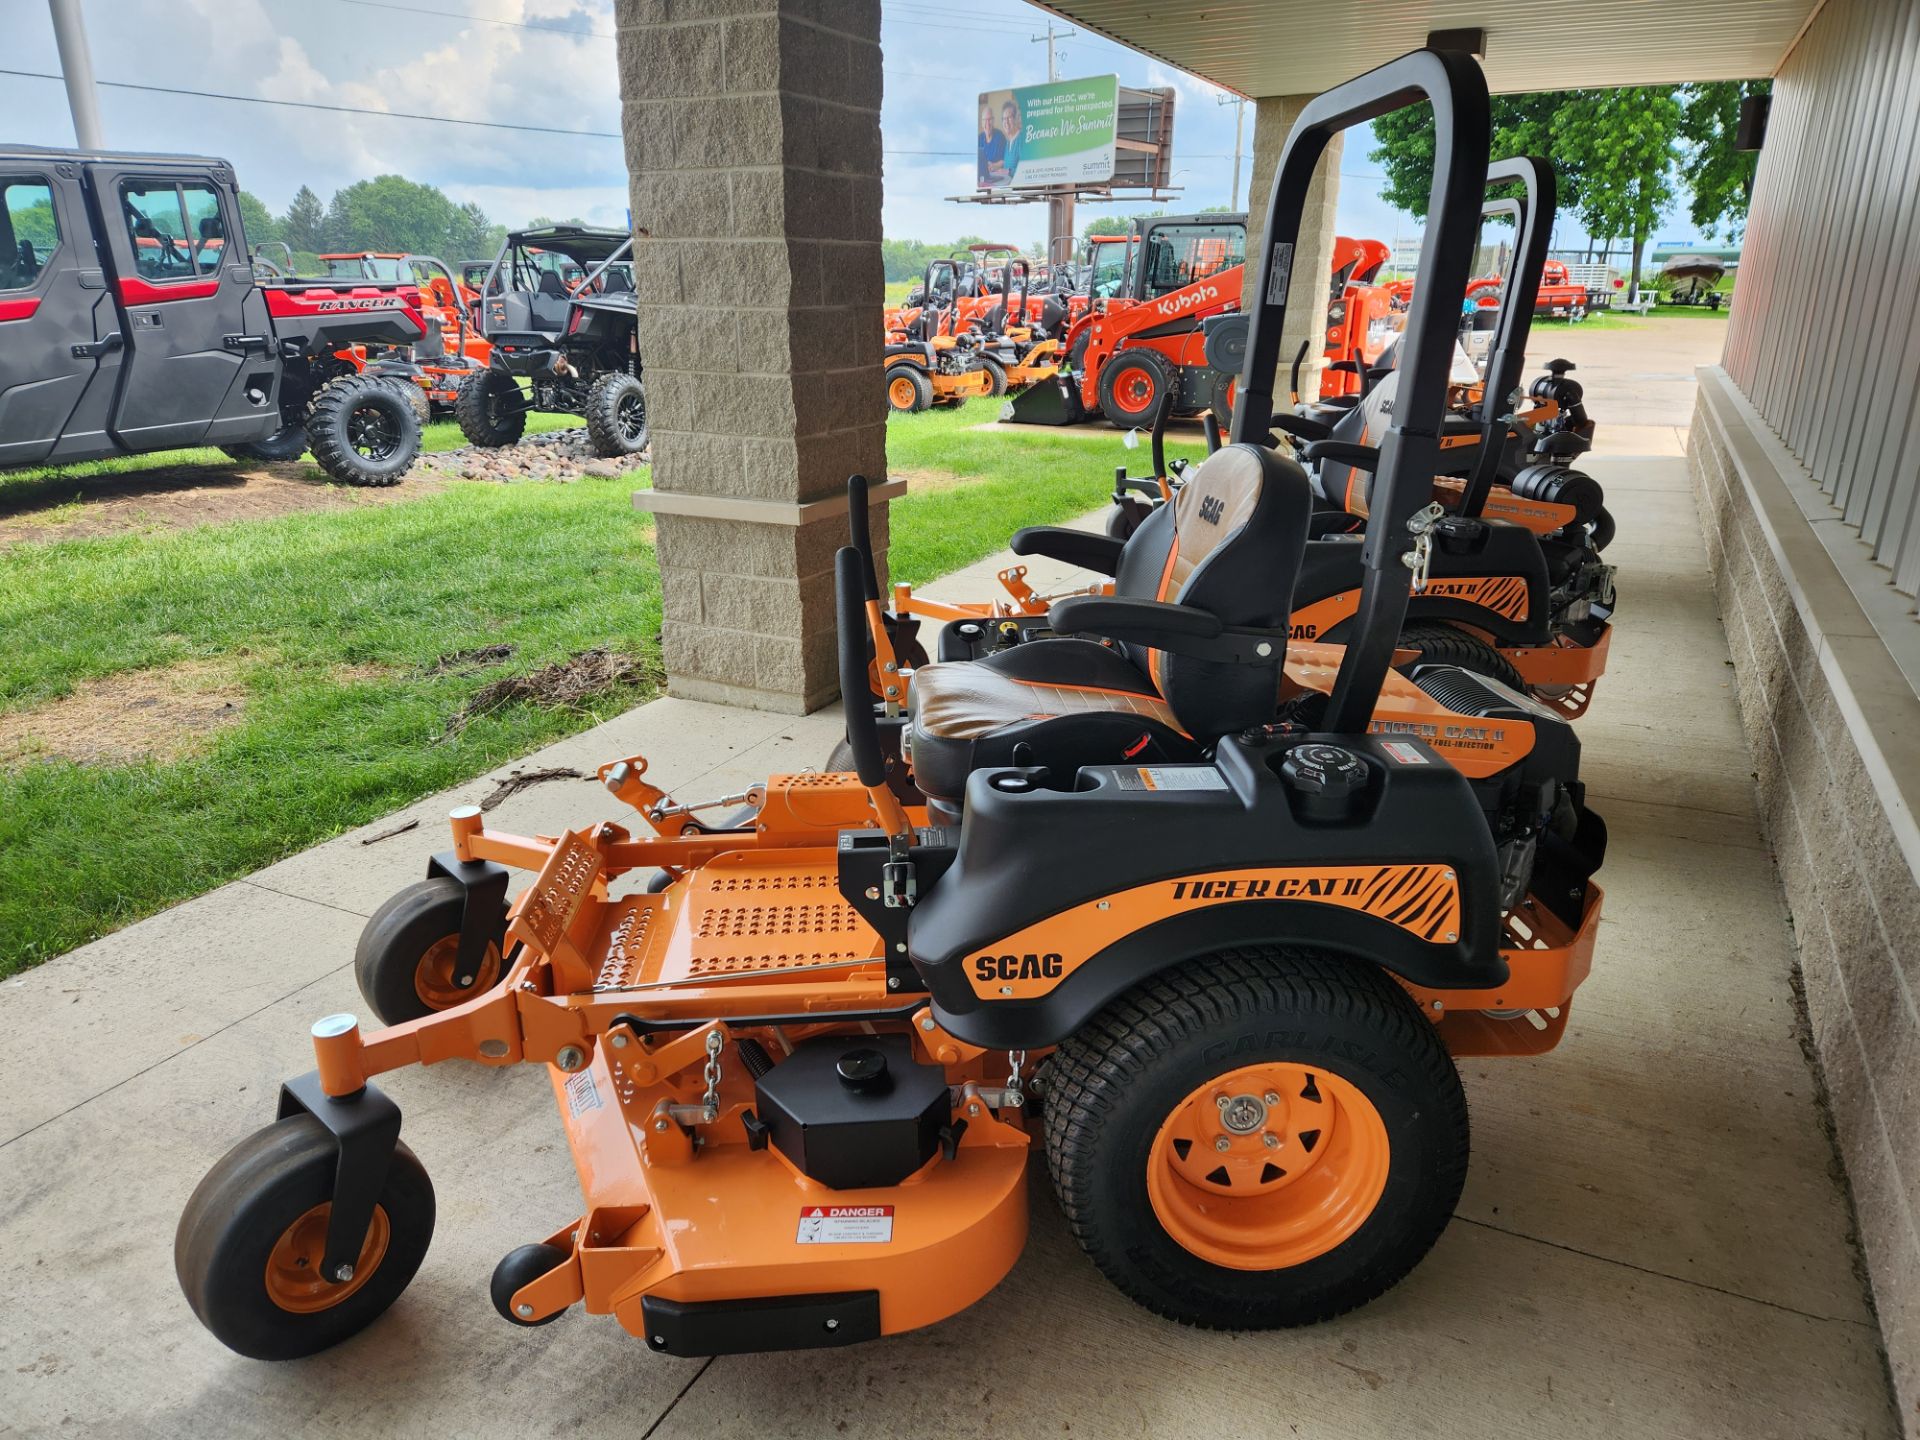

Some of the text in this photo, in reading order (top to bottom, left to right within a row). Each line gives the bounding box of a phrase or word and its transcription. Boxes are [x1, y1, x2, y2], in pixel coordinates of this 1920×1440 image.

[1027, 99, 1042, 107] With
[1053, 94, 1077, 105] HELOC,
[1026, 107, 1054, 118] prepared
[1054, 105, 1063, 114] for
[1064, 103, 1075, 112] the
[1024, 112, 1114, 143] Because We Summit
[1082, 160, 1110, 169] summit
[319, 298, 396, 310] RANGER
[1157, 286, 1218, 315] Kubota
[1198, 494, 1225, 526] SCAG
[1430, 584, 1464, 595] CAT
[1370, 719, 1505, 741] TIGER CAT II
[1433, 738, 1494, 750] FUEL-INJECTION
[1171, 878, 1365, 900] TIGER CAT II
[976, 953, 1063, 982] SCAG
[1201, 1029, 1409, 1091] CARLISLE
[829, 1208, 884, 1217] DANGER
